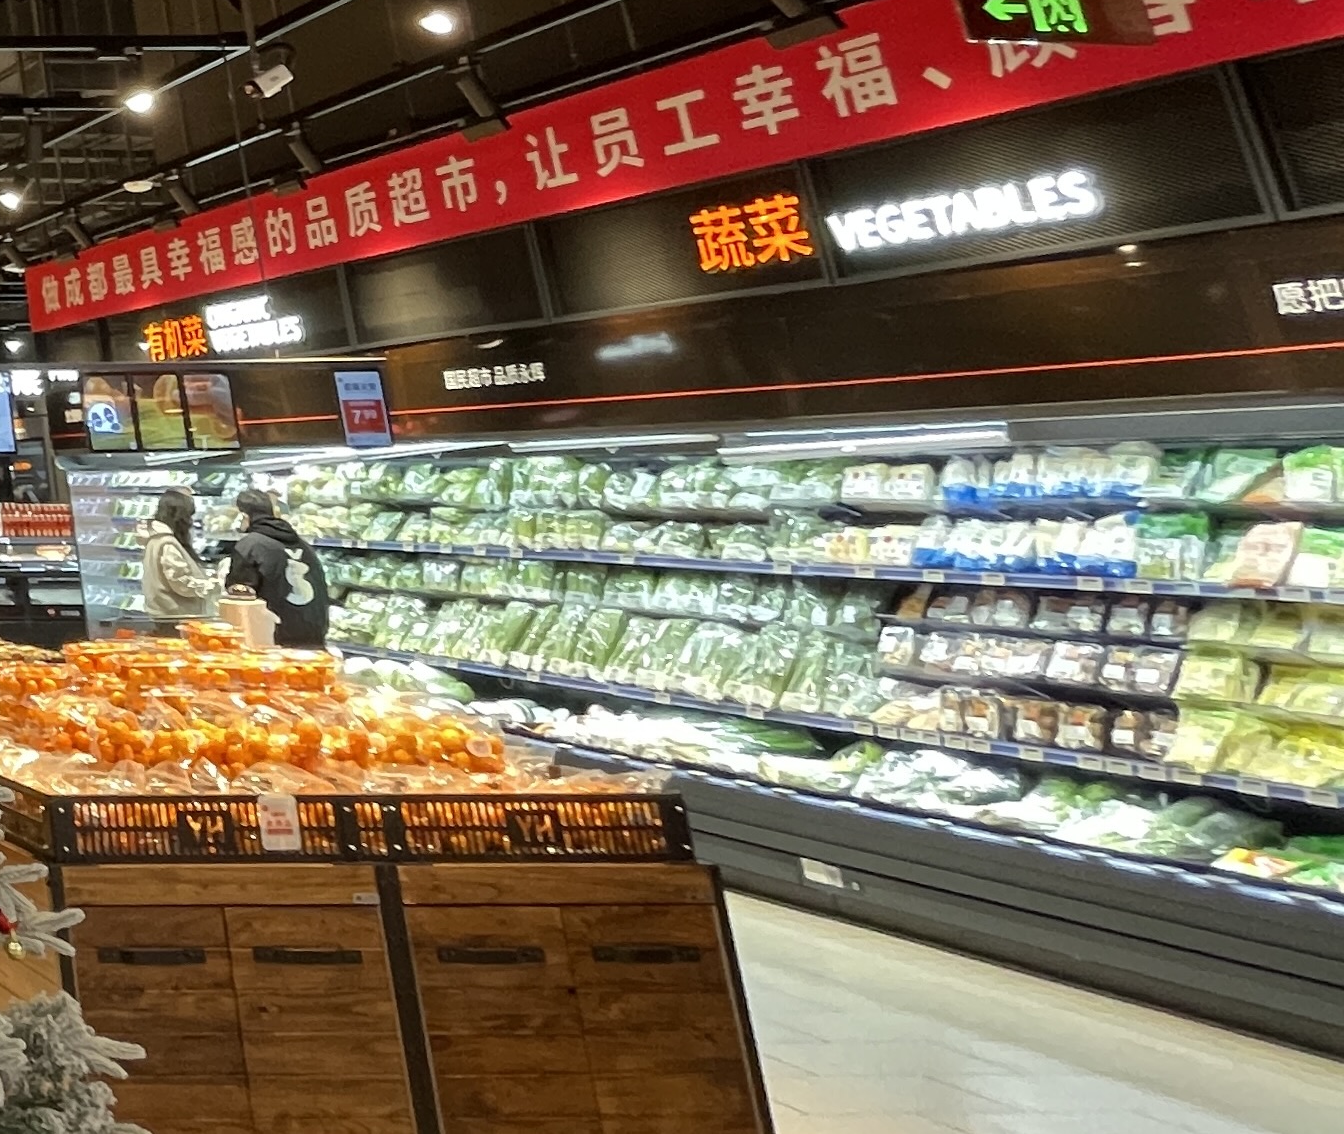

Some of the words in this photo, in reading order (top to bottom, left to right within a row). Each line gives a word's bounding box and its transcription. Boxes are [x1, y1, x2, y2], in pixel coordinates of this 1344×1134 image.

[689, 194, 813, 272] 蔬菜
[826, 169, 1098, 254] VEGETABLES
[1272, 277, 1344, 315] 愿把
[143, 314, 208, 362] 有机菜
